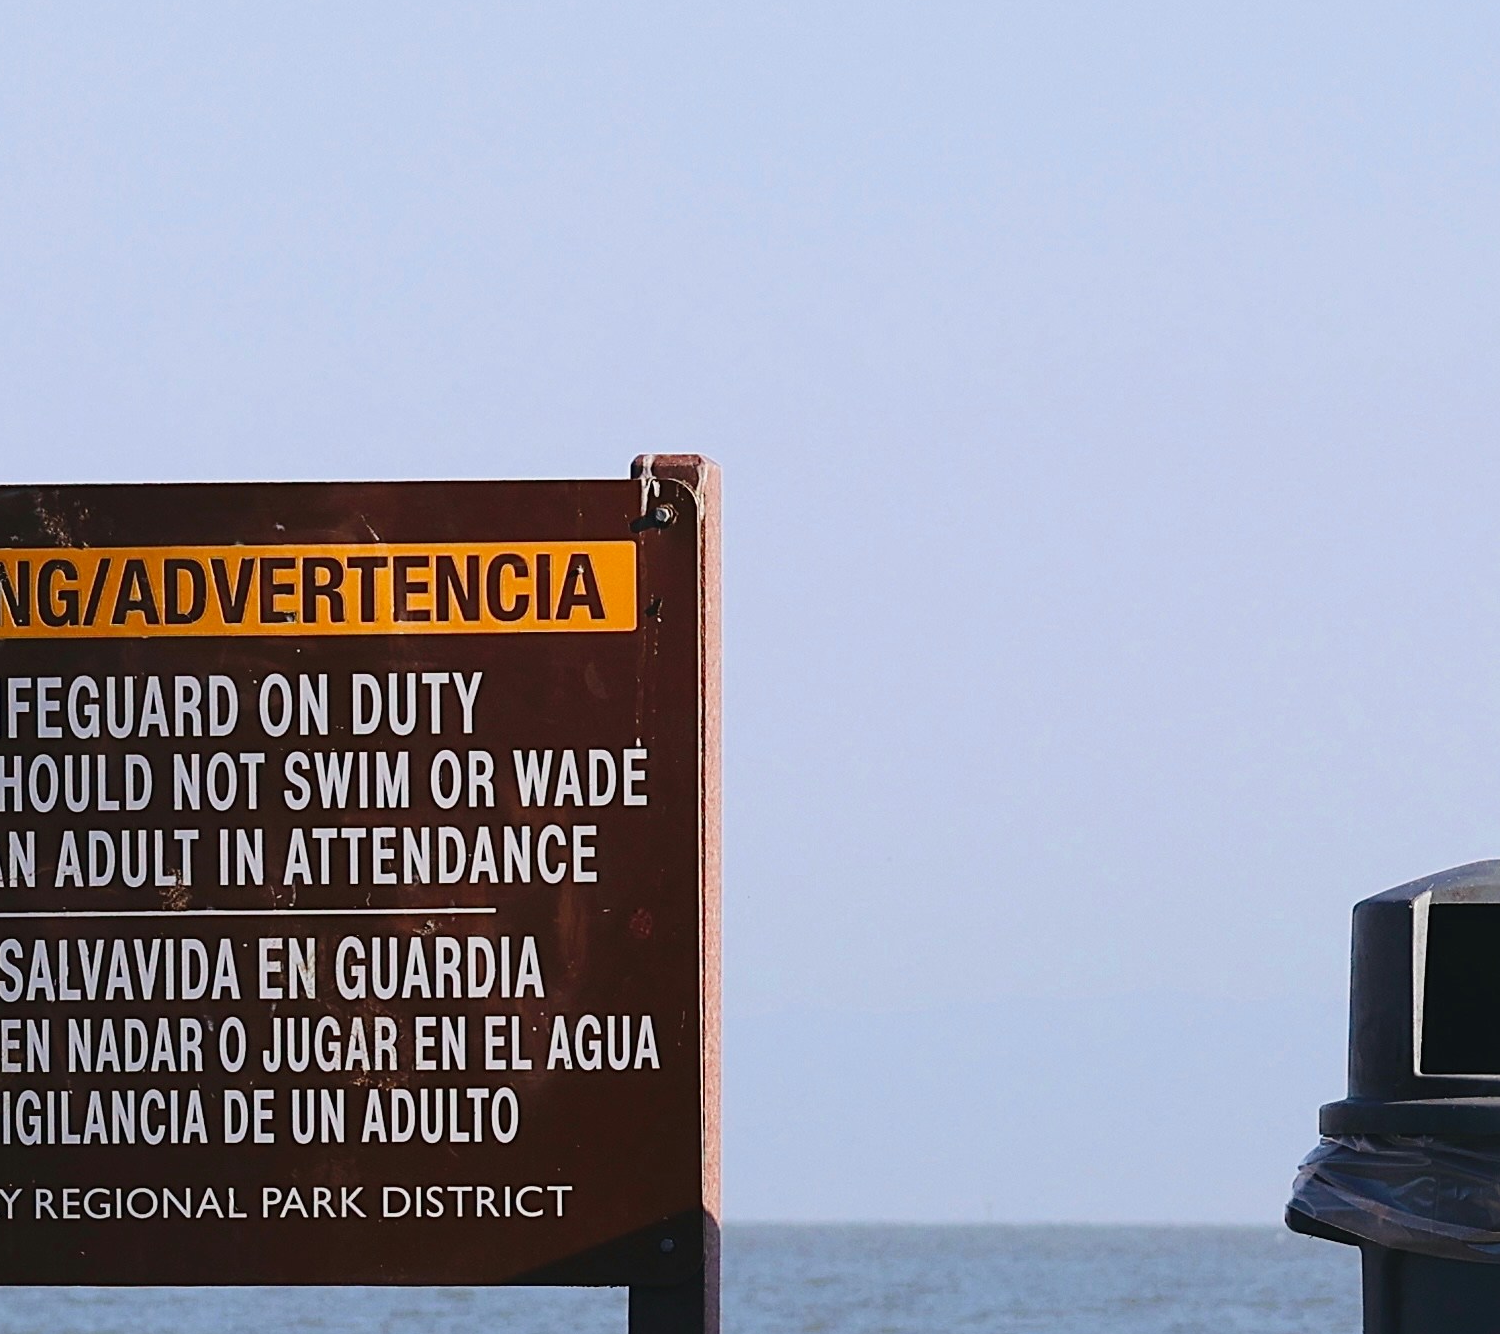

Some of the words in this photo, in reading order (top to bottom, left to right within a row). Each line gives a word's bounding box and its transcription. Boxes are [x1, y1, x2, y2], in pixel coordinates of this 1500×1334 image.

[259, 673, 329, 738] ON
[352, 671, 483, 736] DUTY
[173, 751, 266, 812] NOT
[283, 751, 410, 811] SWIM
[430, 749, 495, 810] OR
[512, 748, 648, 808] WADE
[54, 829, 200, 888] ADULT
[219, 828, 264, 886] IN
[282, 824, 598, 886] ATTENDANCE
[258, 937, 316, 1000] EN
[335, 935, 545, 1001] GUARDIA
[68, 1017, 204, 1073] NADAR
[219, 1016, 247, 1073] O
[262, 1015, 398, 1073] JUGAR
[415, 1015, 466, 1071] EN
[484, 1015, 533, 1071] EL
[546, 1014, 661, 1071] AGUA
[223, 1089, 275, 1144] DE
[291, 1088, 345, 1145] UN
[361, 1086, 519, 1144] ADULTO
[35, 1187, 248, 1220] REGIONAL
[262, 1186, 367, 1219] PARK
[382, 1185, 573, 1218] DISTRICT
